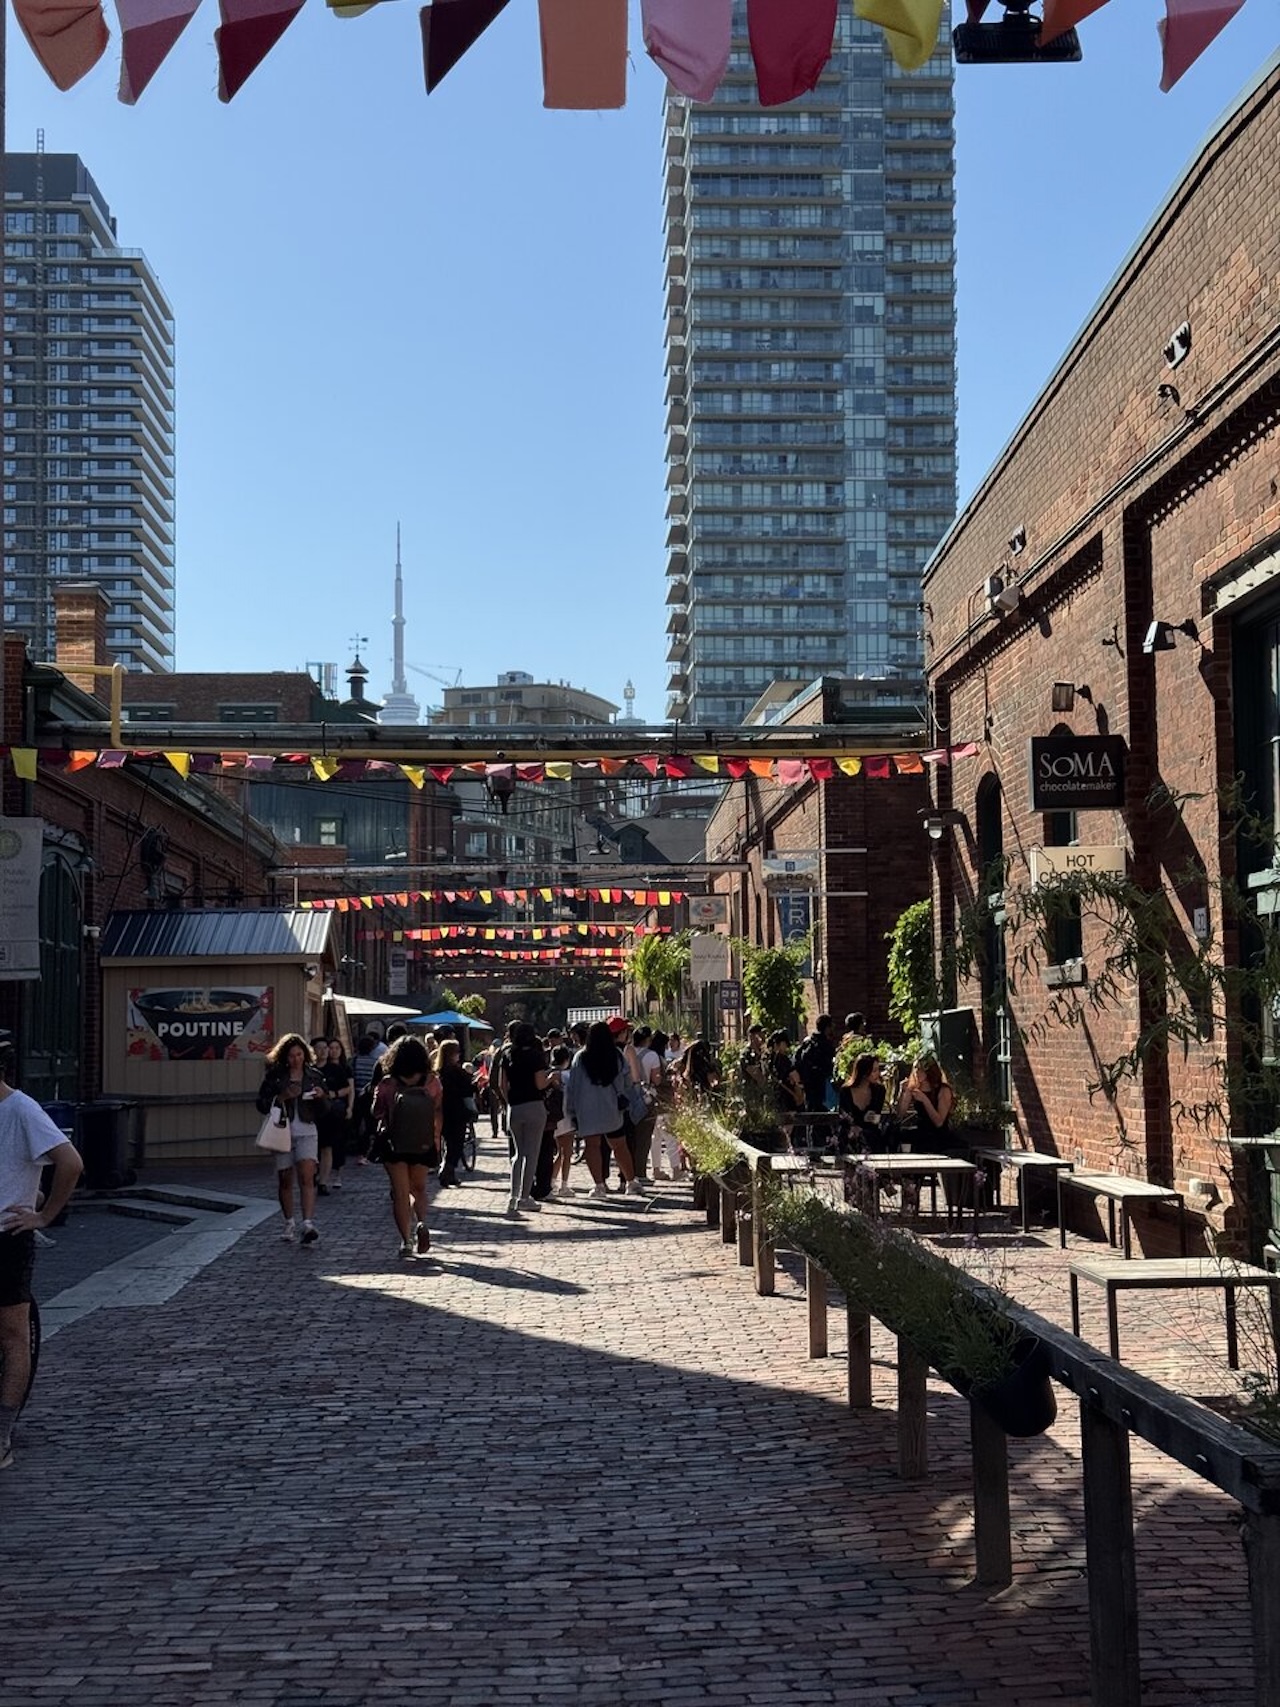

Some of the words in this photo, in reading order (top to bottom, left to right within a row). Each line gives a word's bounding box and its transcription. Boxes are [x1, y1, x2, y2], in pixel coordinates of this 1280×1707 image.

[1039, 752, 1115, 778] SOMA
[1039, 780, 1117, 792] chocolatemaker
[1066, 854, 1096, 868] HOT
[1039, 869, 1123, 884] CHOOATE
[157, 1021, 244, 1038] POUTINE
